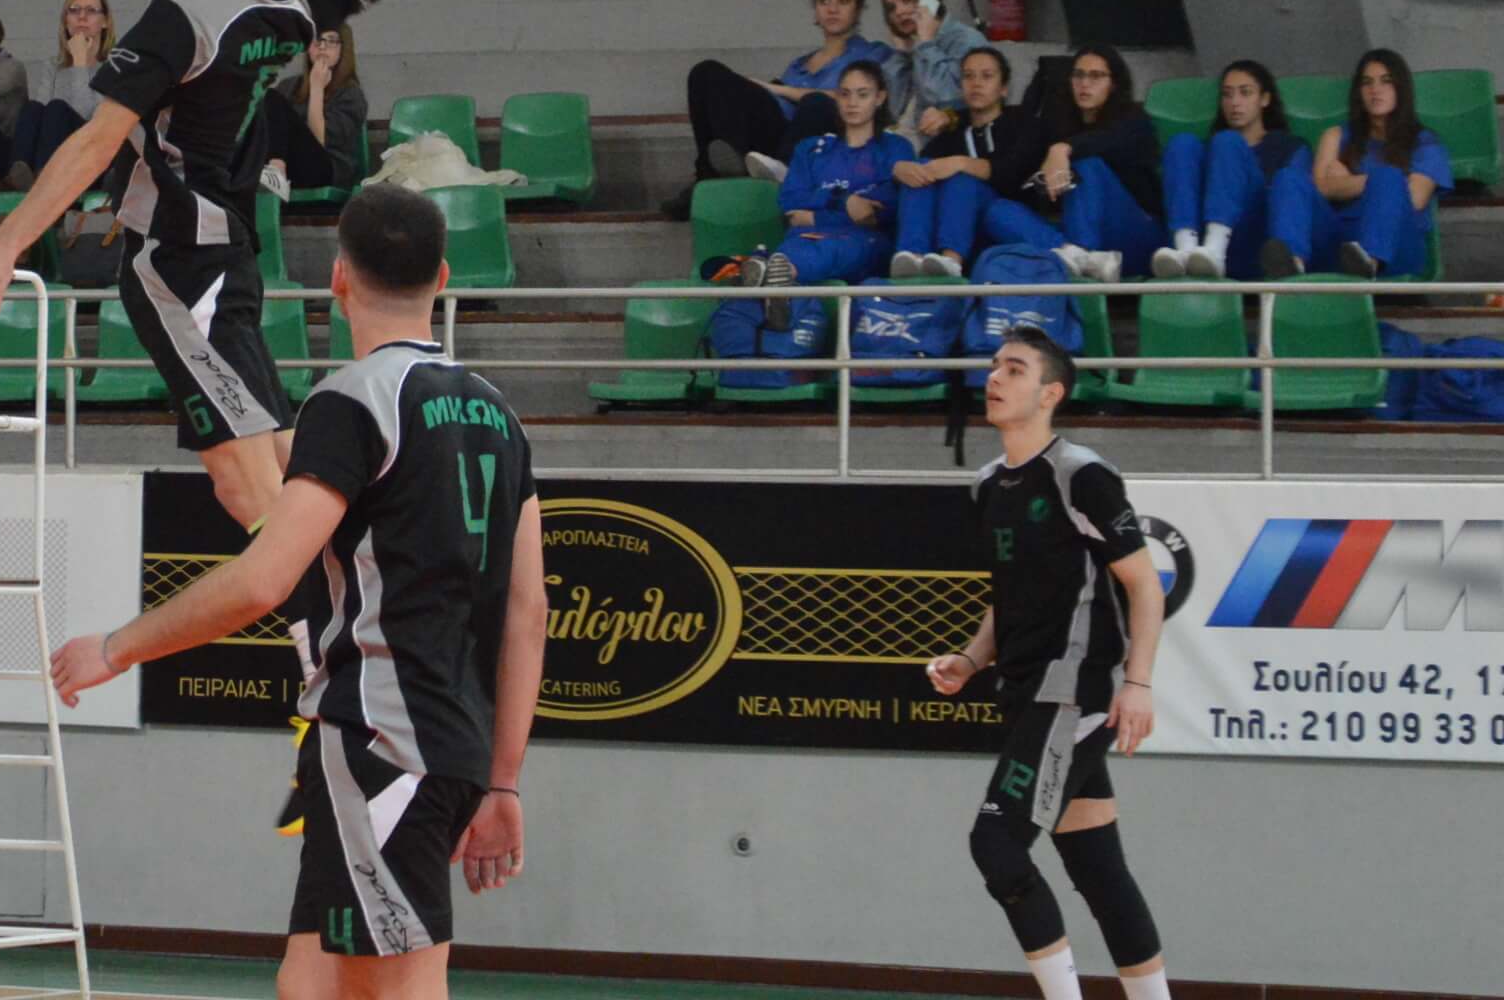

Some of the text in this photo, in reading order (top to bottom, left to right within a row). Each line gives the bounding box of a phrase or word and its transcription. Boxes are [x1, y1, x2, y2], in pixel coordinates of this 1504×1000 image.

[183, 394, 214, 437] 6
[457, 451, 496, 572] 4
[178, 677, 272, 700] ΠΕΙΡΑΙΑΣ
[541, 679, 622, 697] CATERING
[1253, 660, 1387, 694] Σουλίου
[1398, 663, 1454, 701] 42,
[738, 696, 1003, 724] ΝΕΑ ΣΜΥΡΝΗ ΚΕΡΑΤΣ
[1300, 711, 1366, 742] 210
[1380, 713, 1422, 744] 99
[1434, 713, 1476, 745] 33
[999, 760, 1036, 799] 12
[328, 907, 354, 956] 4
